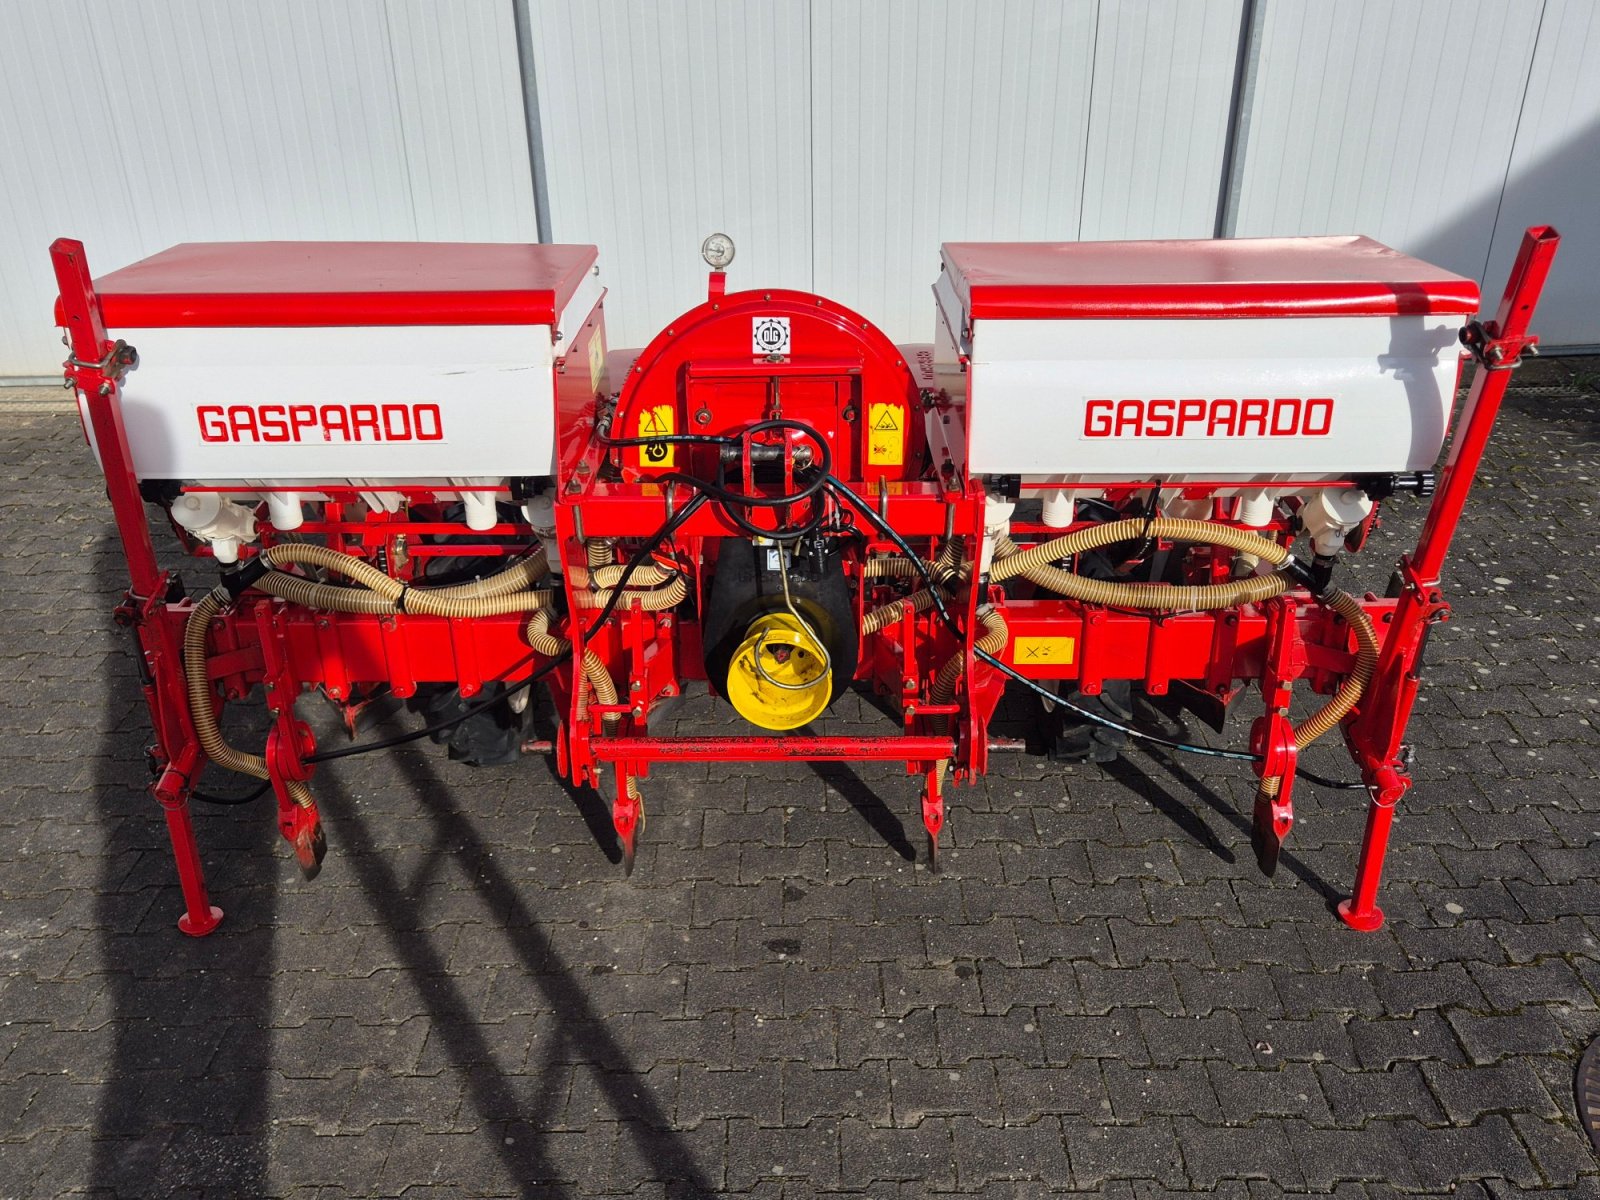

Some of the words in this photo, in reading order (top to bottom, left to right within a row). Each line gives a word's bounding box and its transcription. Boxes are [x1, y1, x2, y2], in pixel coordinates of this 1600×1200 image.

[764, 326, 779, 342] DLG
[197, 404, 443, 442] GASPARDO
[1084, 399, 1334, 437] GASPARDO
